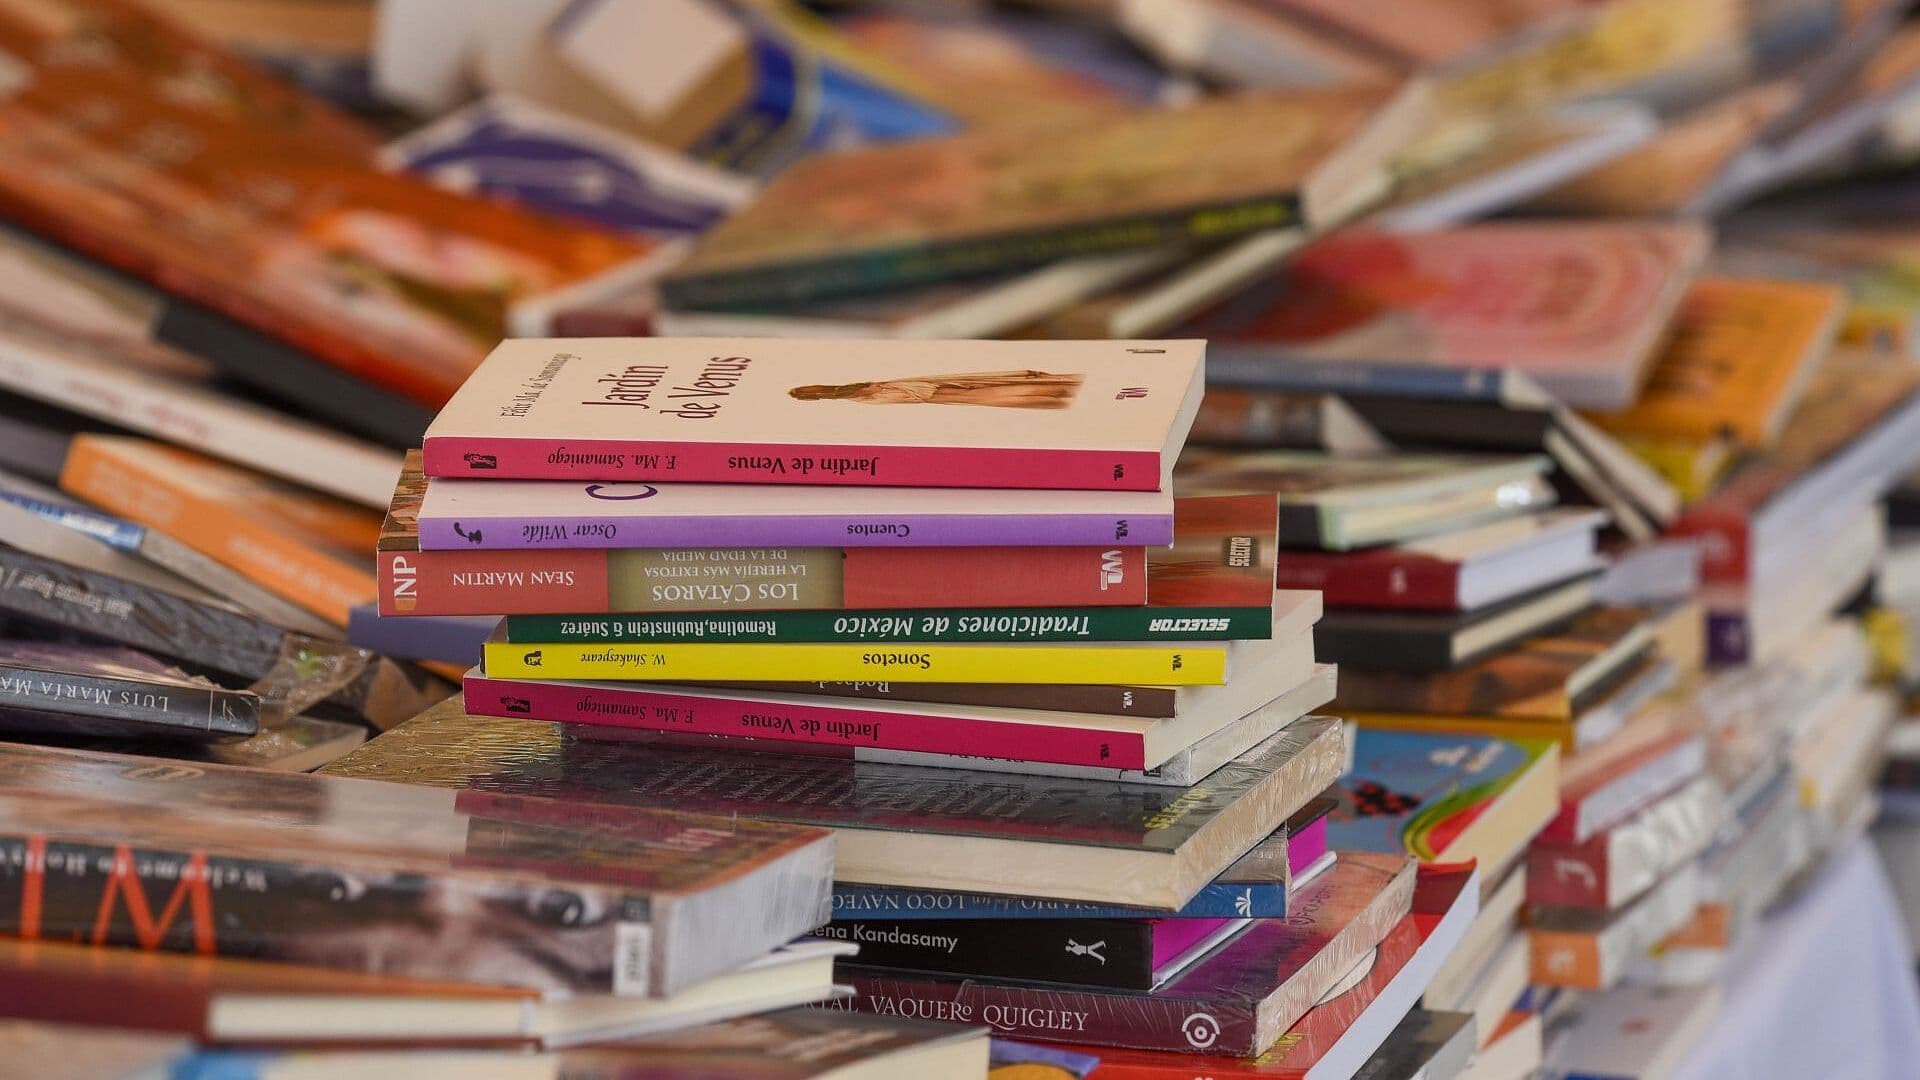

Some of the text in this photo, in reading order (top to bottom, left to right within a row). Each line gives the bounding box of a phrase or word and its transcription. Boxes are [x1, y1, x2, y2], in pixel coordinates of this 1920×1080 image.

[581, 365, 669, 410] Jardín
[659, 356, 752, 419] de Venus
[547, 447, 677, 470] F. Ma. Samaniego
[728, 456, 880, 476] Jardín de Venus
[522, 524, 617, 541] Oscar Wilde
[847, 523, 910, 538] Cuentos
[662, 549, 788, 562] DE LA EDAD MEDIA
[392, 555, 417, 597] NP
[452, 570, 575, 587] SEAN MARTIN
[643, 564, 807, 578] LA HEREJÍA MÁS EXITOSA
[651, 583, 799, 604] LOS CÁTAROS
[560, 621, 609, 637] Suárez
[833, 616, 1091, 637] Tradiciones de México
[1149, 618, 1232, 632] SELECTOR
[580, 649, 667, 666] W. Shakespeare
[862, 653, 931, 669] Sonetos
[41, 682, 113, 707] MARÍA
[120, 691, 169, 712] LUIS
[576, 697, 695, 724] F. Ma. Samaniego
[741, 715, 882, 741] Jardín de Venus
[906, 895, 965, 910] LOCO
[853, 923, 959, 953] Kandasamy
[984, 1005, 1090, 1031] QUIGLEY
